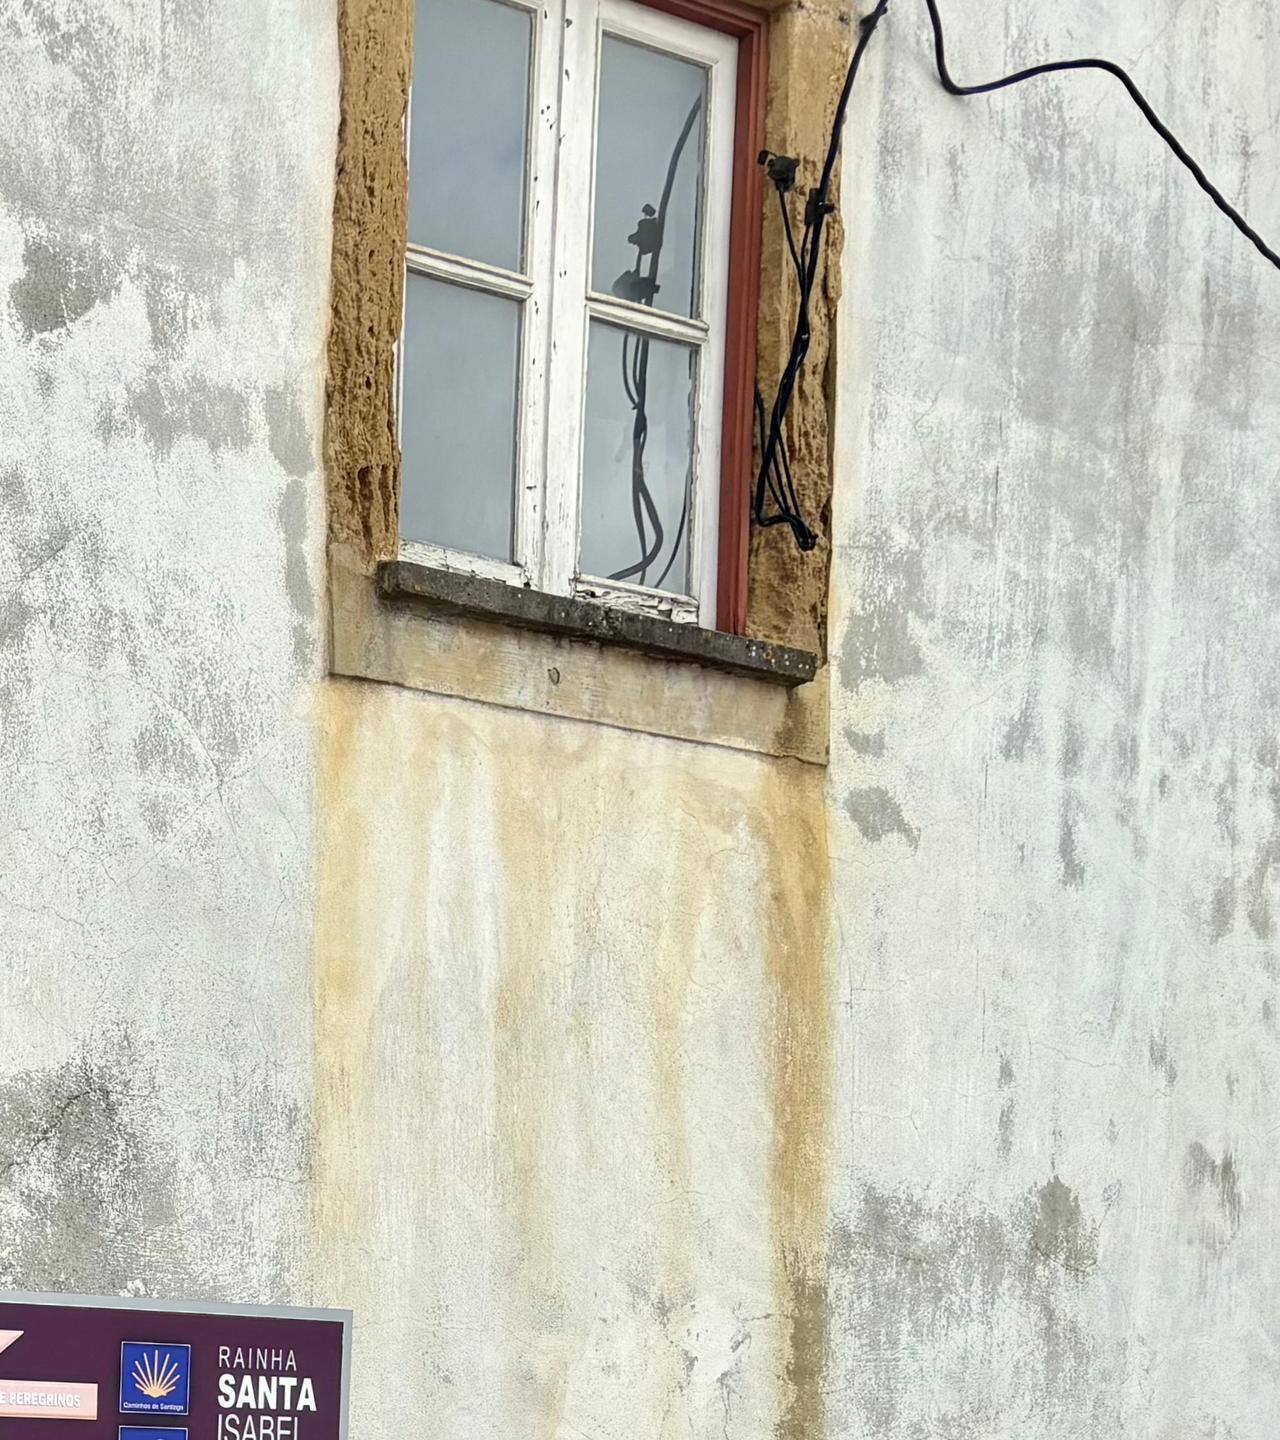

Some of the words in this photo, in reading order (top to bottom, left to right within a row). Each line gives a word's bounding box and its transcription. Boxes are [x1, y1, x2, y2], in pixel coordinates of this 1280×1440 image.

[218, 1345, 297, 1371] RAINHA
[9, 1391, 81, 1408] PEREGRINOS
[217, 1373, 317, 1412] SANTA
